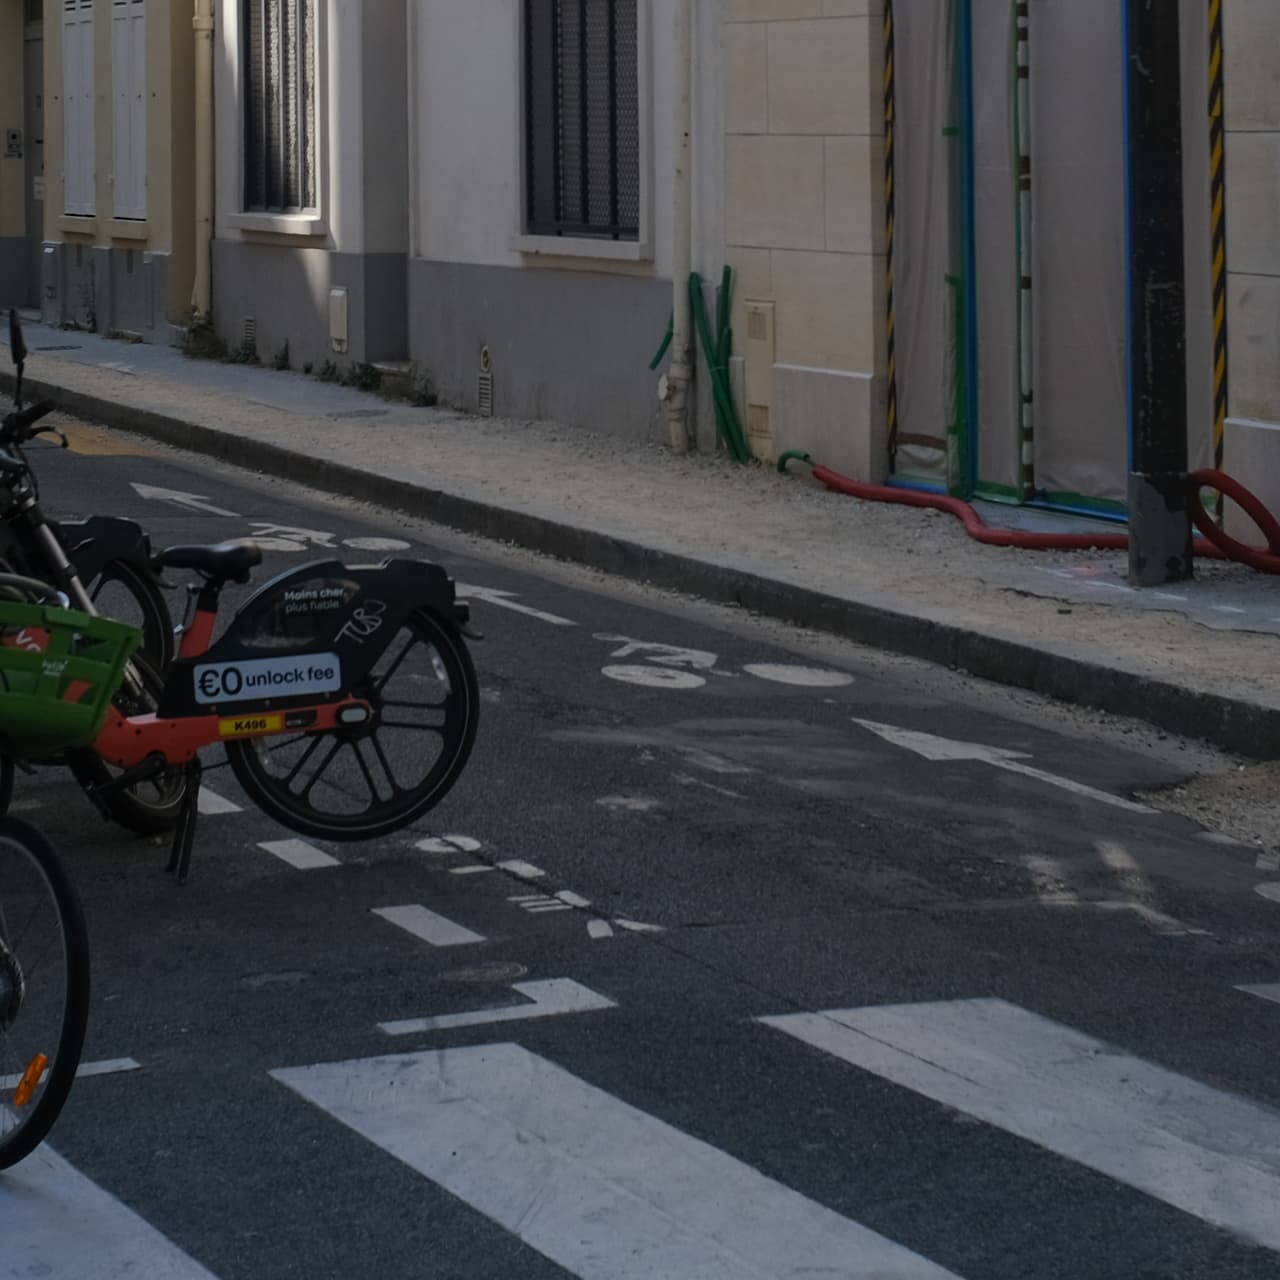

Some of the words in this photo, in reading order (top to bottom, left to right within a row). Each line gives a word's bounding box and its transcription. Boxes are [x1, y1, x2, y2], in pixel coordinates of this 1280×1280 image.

[283, 589, 317, 602] Moins
[284, 601, 308, 614] plus
[198, 667, 243, 697] €0
[246, 667, 304, 687] unlock
[307, 665, 334, 681] fee
[234, 718, 267, 731] K496
